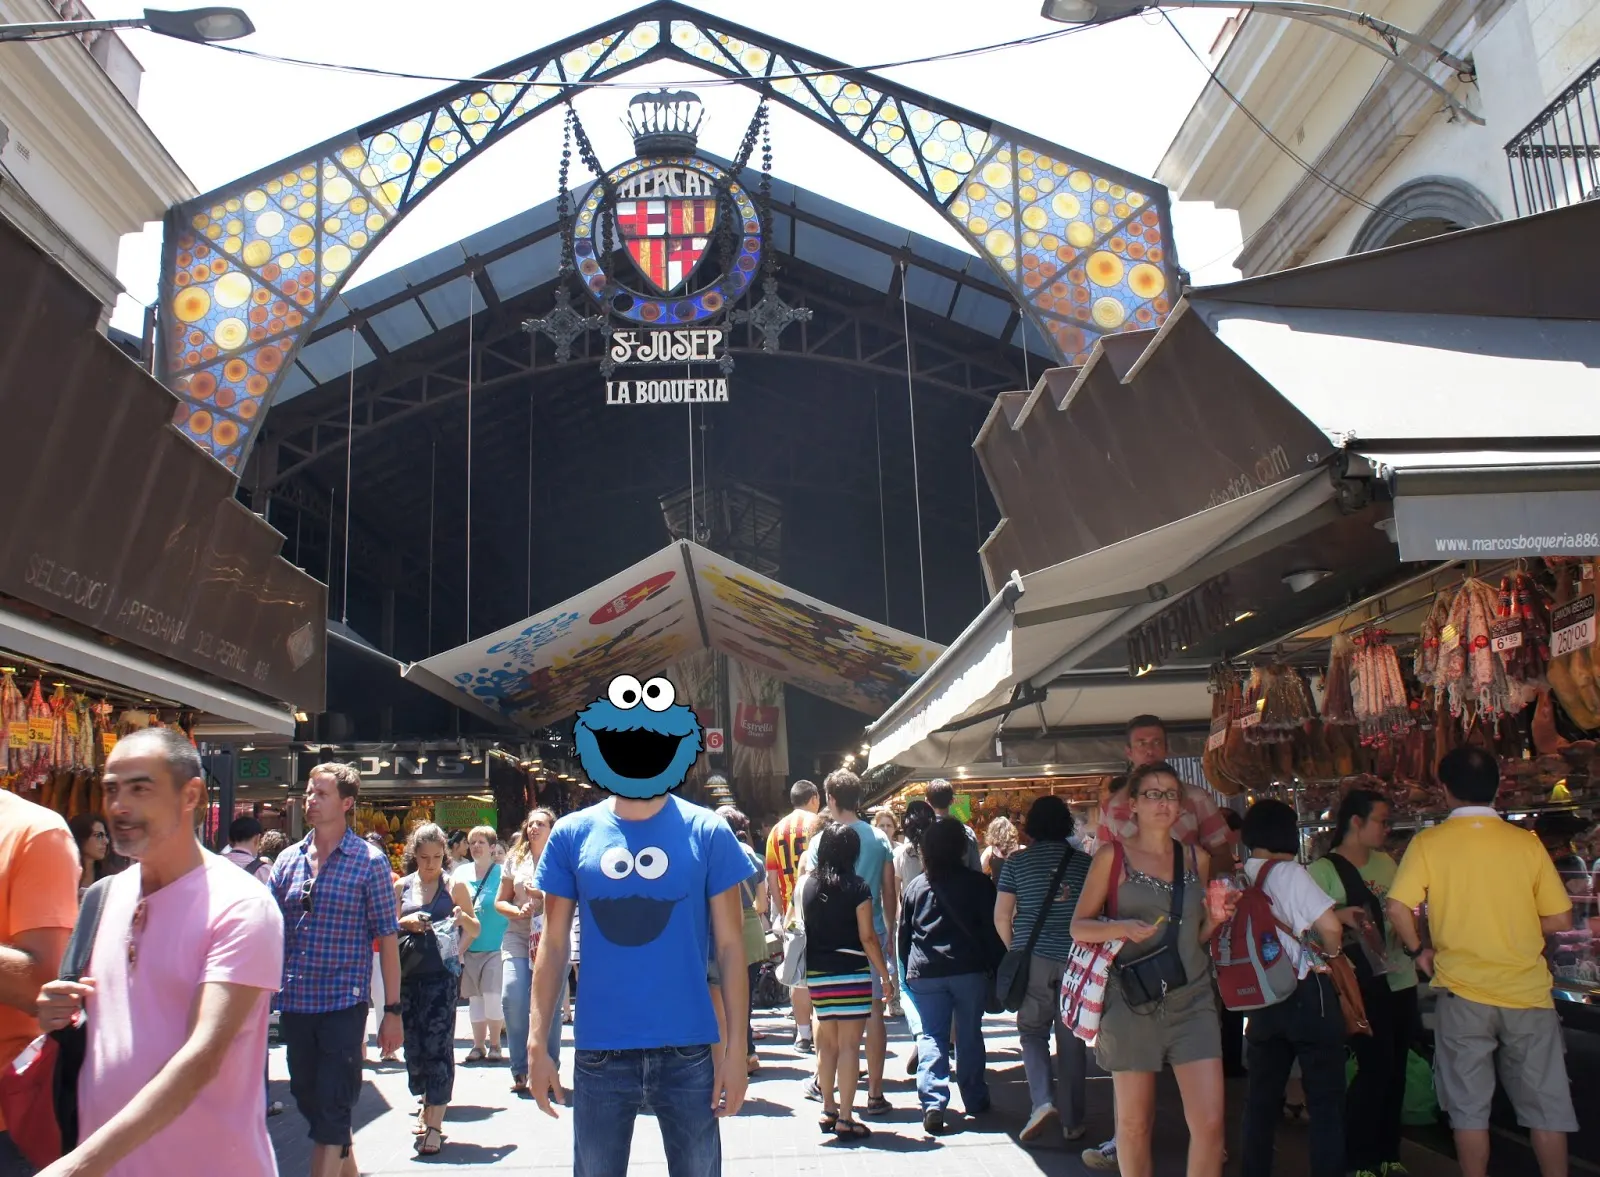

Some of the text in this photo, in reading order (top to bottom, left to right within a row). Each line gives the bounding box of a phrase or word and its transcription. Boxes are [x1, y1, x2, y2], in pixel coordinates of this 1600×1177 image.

[617, 167, 714, 198] MERCAT
[637, 329, 722, 361] JOSEP
[606, 379, 729, 404] LA BOQUERIA
[740, 720, 773, 732] Estrella
[711, 735, 719, 746] 6
